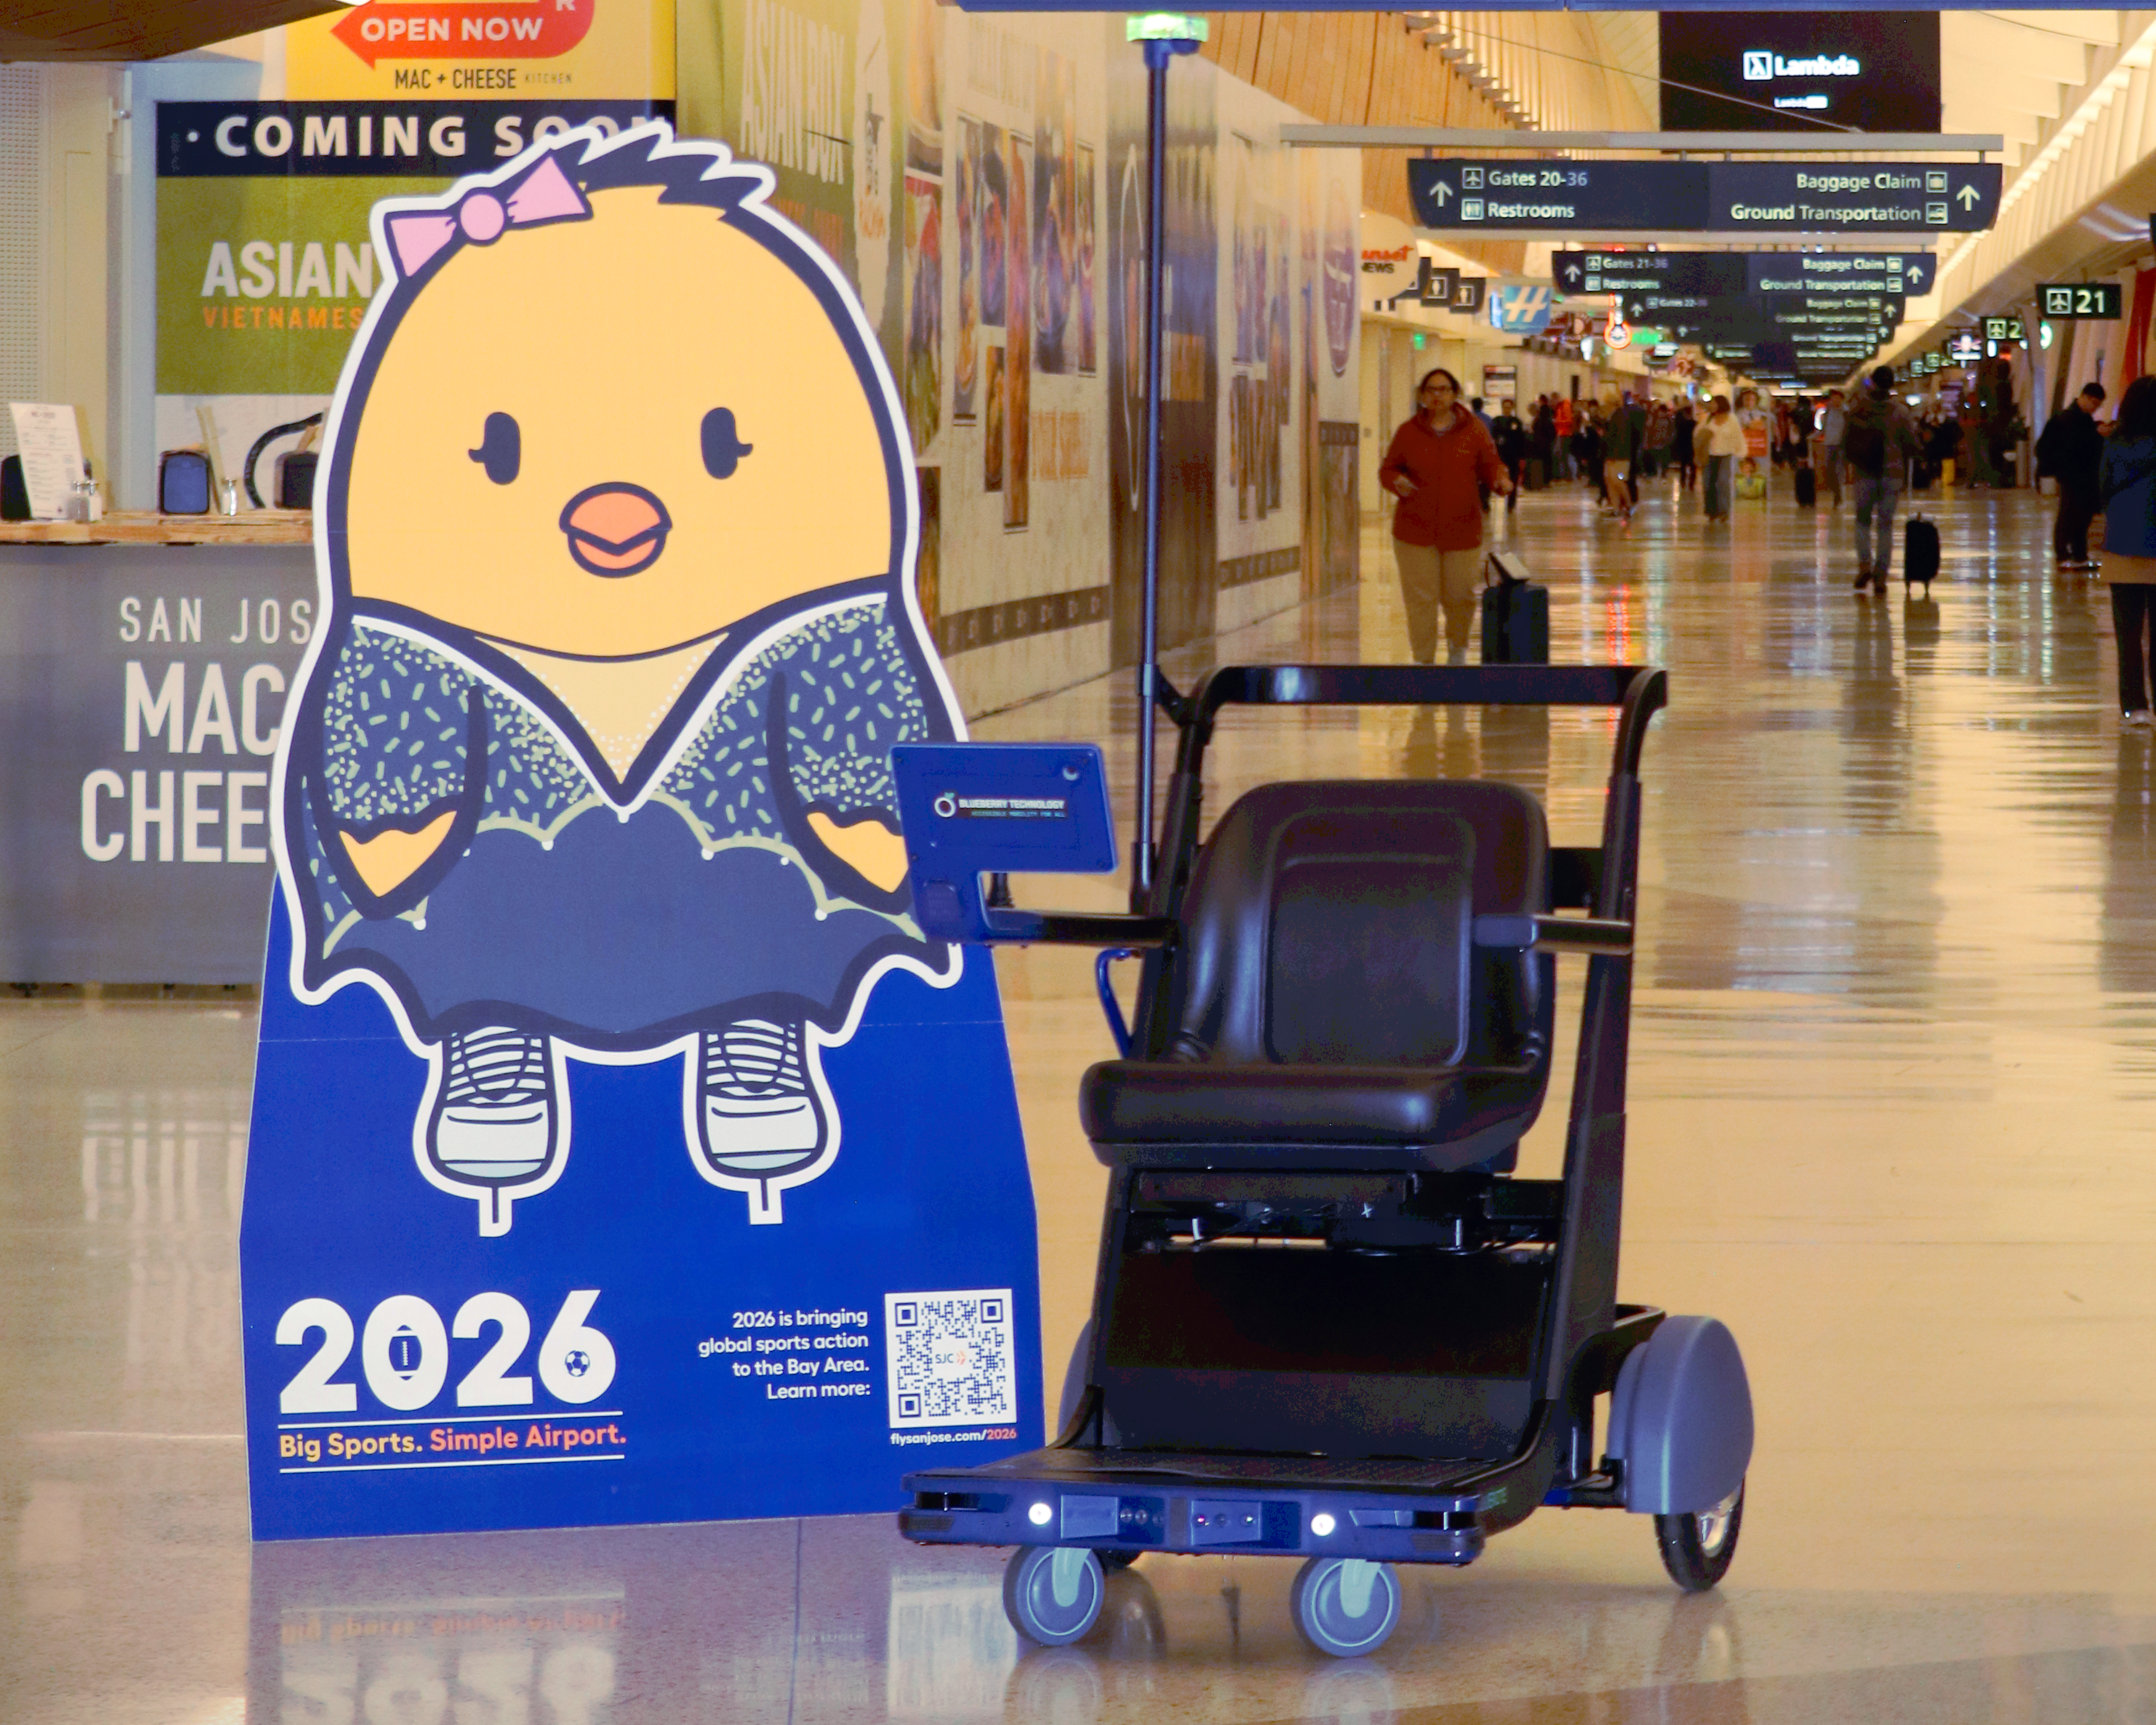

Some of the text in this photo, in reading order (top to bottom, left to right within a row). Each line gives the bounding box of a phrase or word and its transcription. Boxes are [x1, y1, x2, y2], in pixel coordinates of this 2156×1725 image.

[360, 17, 543, 41] OPEN NOW
[1774, 54, 1860, 76] Lambda
[395, 69, 431, 89] MAC
[453, 68, 516, 89] CHEESE
[215, 115, 465, 157] COMING
[1489, 171, 1588, 187] Gates 20-36
[1797, 173, 1921, 192] Baggage Claim
[1488, 203, 1575, 218] Restrooms
[1730, 204, 1921, 224] Ground Transportation
[201, 241, 373, 298] ASIAN
[1603, 258, 1634, 269] Gates
[1802, 258, 1885, 272] Baggage Claim
[1603, 279, 1660, 290] Restrooms
[1760, 279, 1885, 292] Ground Transportation
[2076, 289, 2105, 313] 21
[203, 306, 364, 329] VIETNAMES
[2009, 322, 2021, 339] 2
[119, 597, 311, 645] SAN JOS
[124, 661, 285, 756] MAC
[959, 799, 1065, 809] BLUEBERRY TECHNOLOGY
[81, 768, 273, 863] CHEE
[733, 1307, 868, 1328] 2026 is bringing
[275, 1289, 616, 1414] 2026
[698, 1332, 869, 1358] global sports action
[732, 1356, 870, 1376] to the Bay Area.
[935, 1353, 954, 1364] SJC
[767, 1383, 871, 1400] Learn more:
[280, 1423, 627, 1462] Big Sports. Simple Airport.
[890, 1428, 1017, 1446] flysanjose.com/2026
